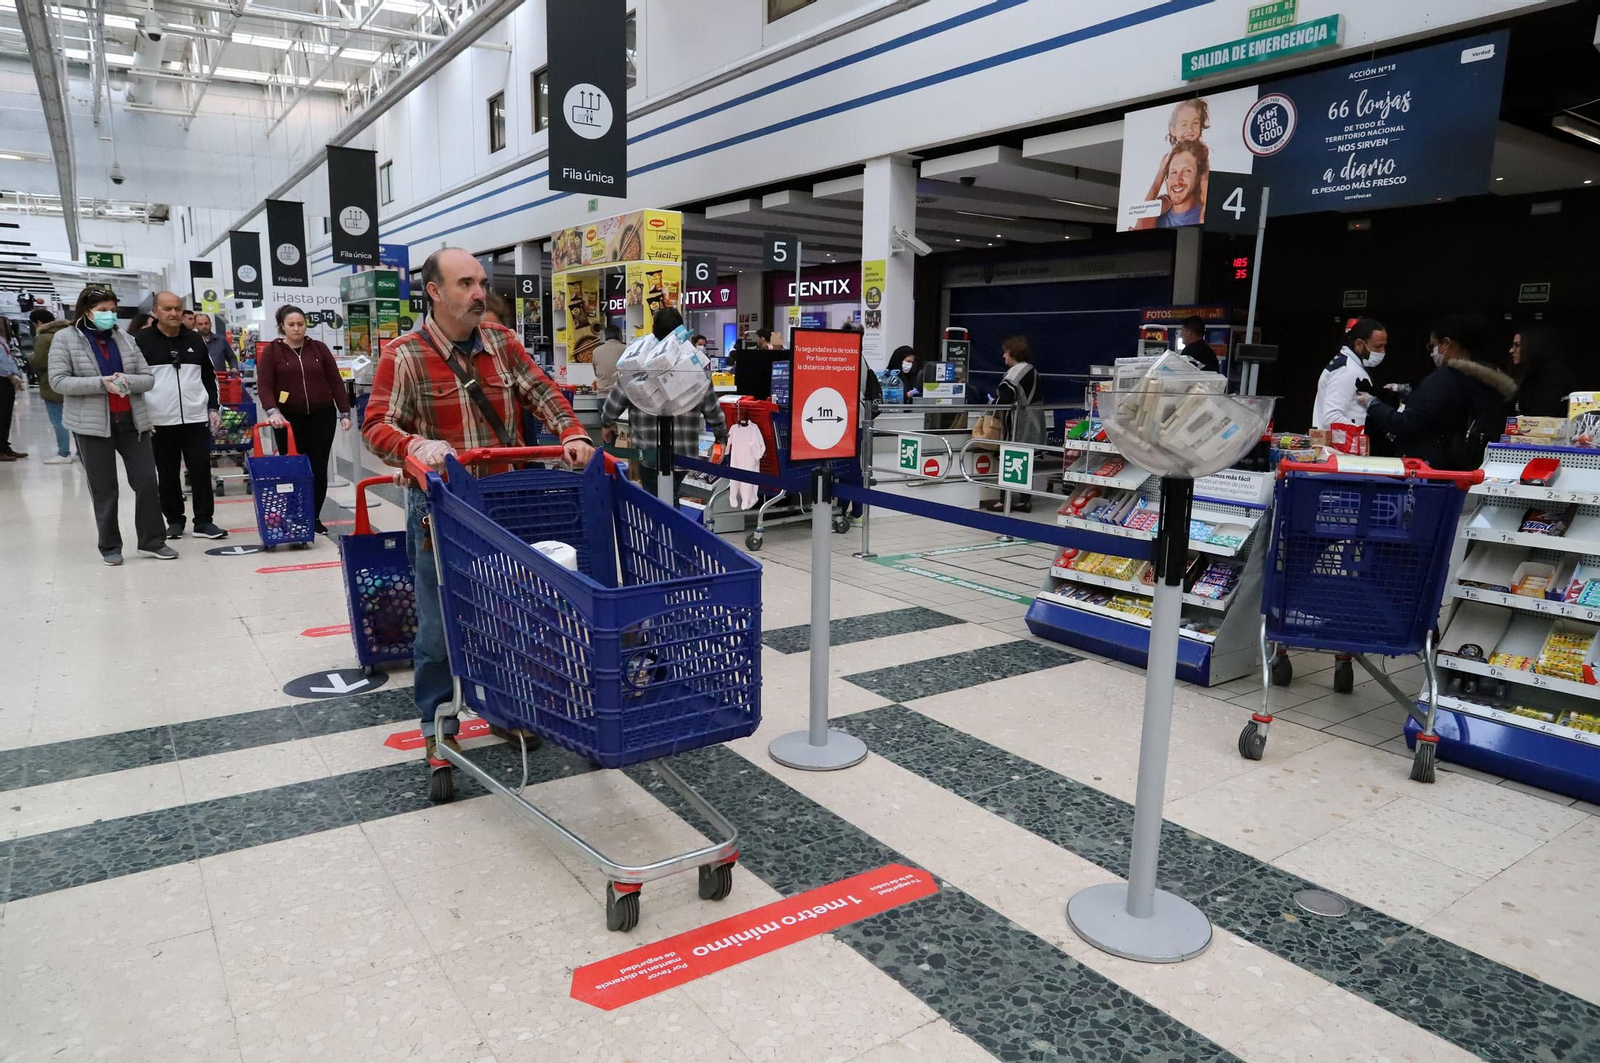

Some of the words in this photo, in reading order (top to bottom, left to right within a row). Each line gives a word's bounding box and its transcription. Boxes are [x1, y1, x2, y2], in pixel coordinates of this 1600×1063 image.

[1251, 5, 1278, 19] SALIDA
[1284, 1, 1294, 10] DE
[1248, 13, 1294, 31] EMERGENCIA
[1190, 52, 1230, 71] SALIDA
[1231, 44, 1247, 62] DE
[1248, 23, 1328, 57] EMERGENCIA
[1471, 49, 1491, 58] Verdad
[1348, 66, 1377, 80] ACCIÓN
[1328, 99, 1349, 120] 66
[1356, 89, 1413, 119] lonjas
[1260, 117, 1278, 133] FOR
[1355, 122, 1376, 131] TODO
[1377, 119, 1386, 127] EL
[1259, 126, 1283, 144] FOOD
[1325, 131, 1366, 143] TERRITORIO
[1367, 125, 1405, 137] NACIONAL
[1337, 142, 1356, 153] NOS
[1357, 138, 1389, 150] SIRVEN
[1323, 168, 1335, 183] a
[1340, 152, 1396, 181] diario
[562, 167, 582, 180] Fila
[584, 170, 614, 184] única
[1320, 183, 1351, 194] PESCADO
[1352, 178, 1371, 190] MÁS
[1372, 175, 1407, 188] FRESCO
[1222, 187, 1246, 220] 4
[340, 250, 353, 258] Fila
[354, 250, 372, 259] única
[772, 241, 787, 262] 5
[1233, 257, 1248, 268] 185
[695, 263, 708, 280] 6
[1235, 270, 1247, 279] 35
[522, 279, 533, 293] 8
[613, 275, 624, 290] 7
[788, 279, 850, 297] DENTIX
[272, 292, 314, 304] ¡Hasta
[412, 299, 422, 309] 11
[600, 301, 608, 311] 7
[310, 313, 319, 322] 15
[322, 311, 333, 320] 14
[1146, 310, 1172, 319] FOTOS
[802, 346, 826, 354] seguridad
[818, 407, 833, 417] 1m
[877, 881, 911, 895] seguridad
[847, 895, 863, 905] 1
[781, 898, 848, 926] metro
[692, 921, 780, 957] mínimo
[620, 956, 664, 974] seguridad
[647, 957, 682, 971] manten
[672, 963, 688, 972] Por
[595, 973, 638, 990] distancia
[647, 969, 672, 980] favor
